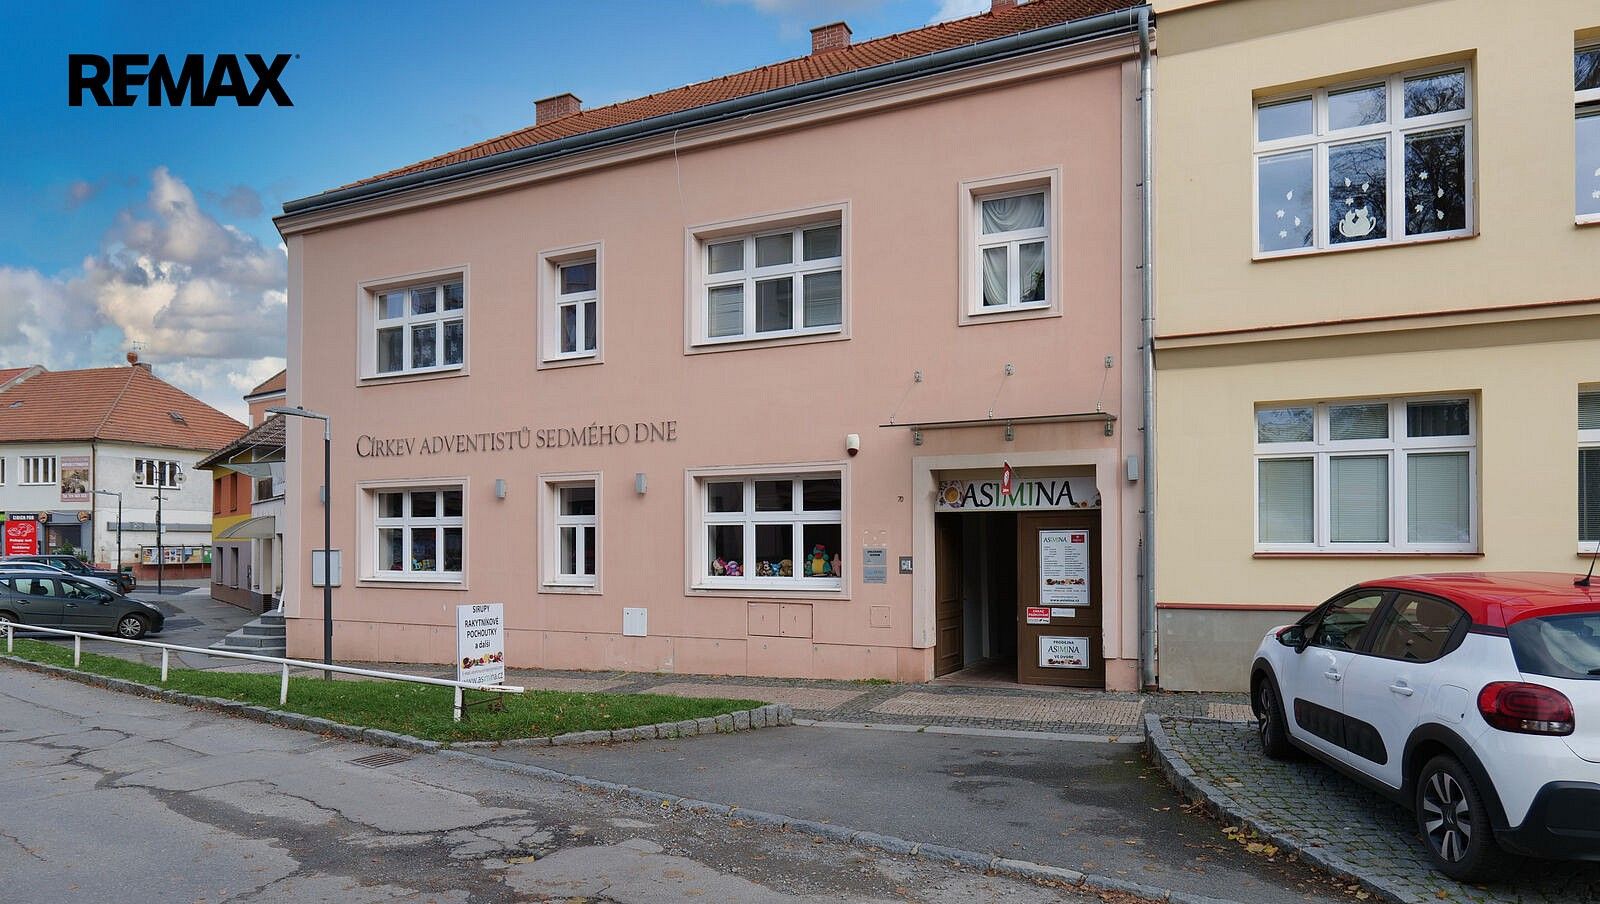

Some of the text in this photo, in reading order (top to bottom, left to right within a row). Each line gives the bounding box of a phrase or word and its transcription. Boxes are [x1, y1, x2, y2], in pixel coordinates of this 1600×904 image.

[356, 420, 678, 459] CÍRKEV ADVENTISTŮ SEDMÉHO DNE
[960, 480, 1078, 508] ASIMINA
[473, 605, 489, 613] SIRUPY
[465, 617, 498, 627] RAKYTNÍKOVÉ
[467, 628, 497, 638] POCHOUTKY
